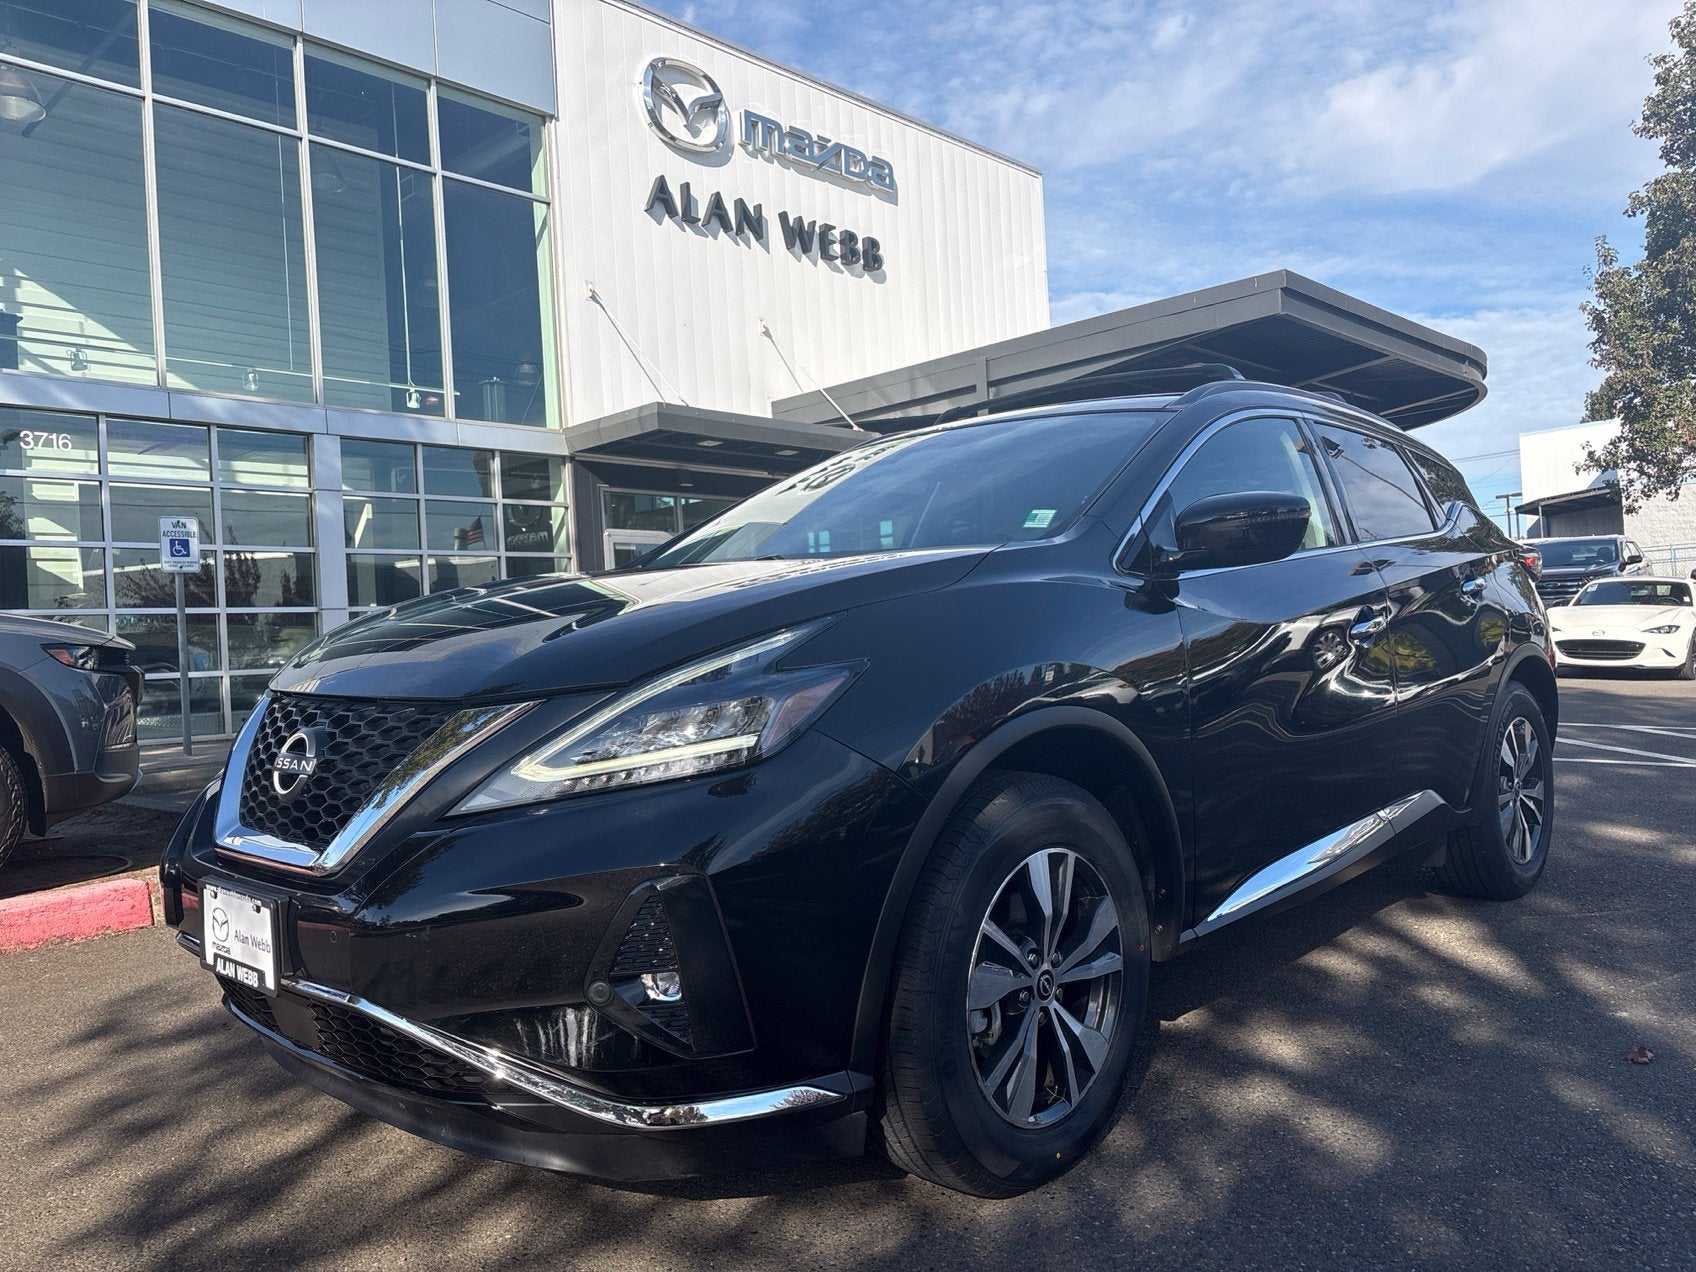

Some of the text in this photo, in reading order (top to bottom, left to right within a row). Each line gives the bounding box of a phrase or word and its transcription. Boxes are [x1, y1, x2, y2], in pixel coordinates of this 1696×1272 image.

[644, 174, 883, 272] ALAN WEBB
[19, 430, 72, 451] 3716
[162, 530, 197, 538] ACCESSIBLE
[171, 520, 187, 529] VAN
[276, 758, 313, 772] SSAN
[234, 929, 271, 953] Alan Webb
[216, 957, 258, 987] ALAN WEBB
